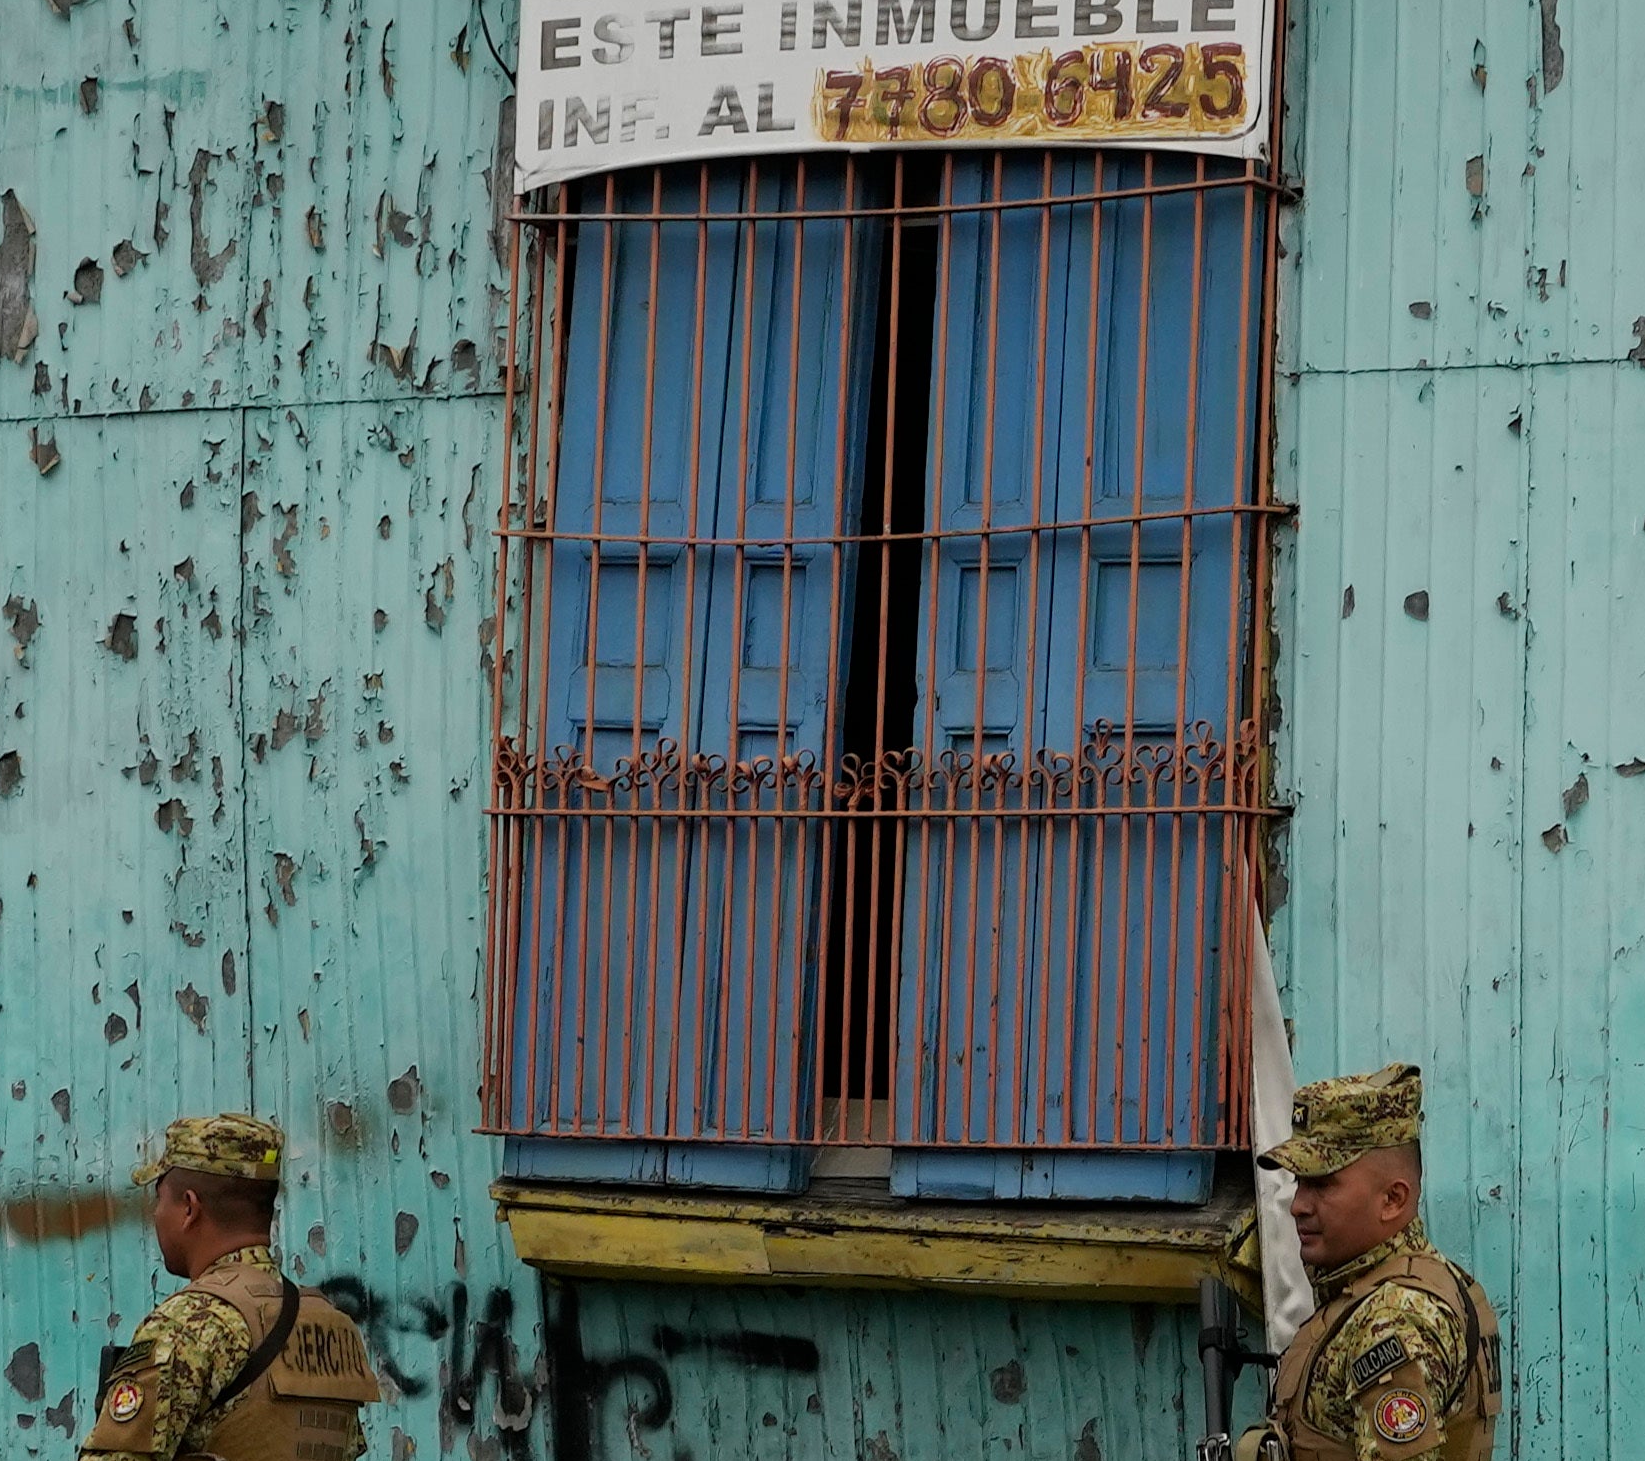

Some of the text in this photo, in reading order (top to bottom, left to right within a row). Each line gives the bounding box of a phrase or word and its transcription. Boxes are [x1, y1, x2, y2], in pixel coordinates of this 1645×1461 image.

[540, 4, 745, 71] ESTE
[537, 93, 670, 151] INF.
[697, 81, 796, 137] AL
[1352, 1338, 1402, 1382] VULCANO
